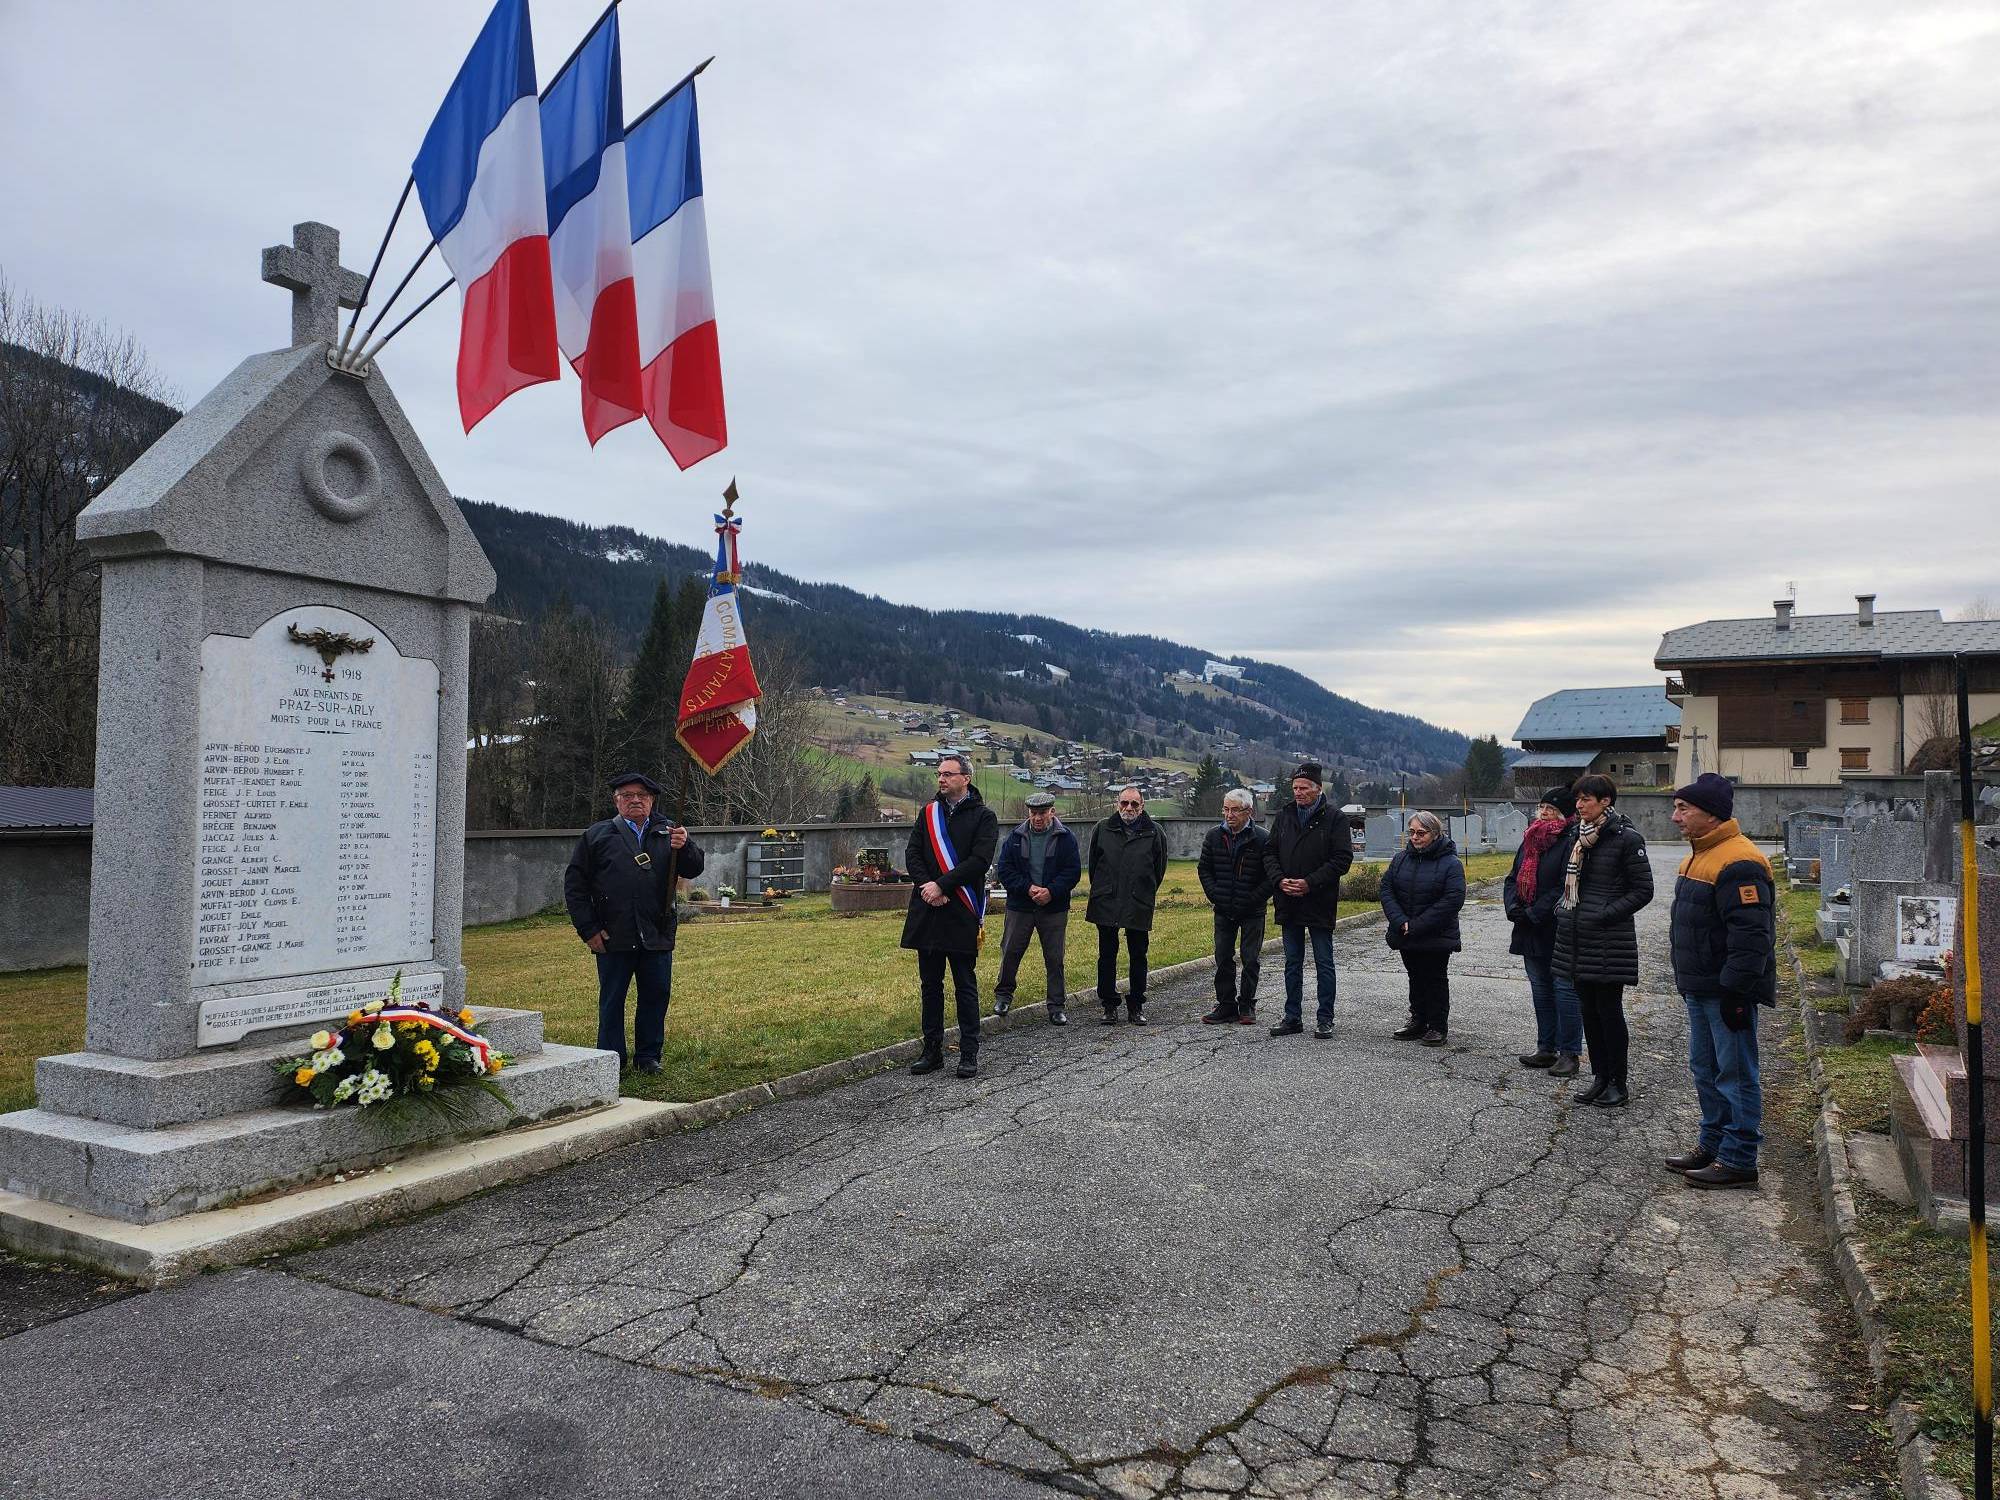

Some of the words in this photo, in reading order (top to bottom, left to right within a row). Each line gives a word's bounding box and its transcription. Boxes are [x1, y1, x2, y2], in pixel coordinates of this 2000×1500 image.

[296, 664, 318, 676] 1914
[342, 668, 362, 681] 1918
[292, 688, 310, 698] AUX
[313, 689, 350, 701] ENFANTS
[352, 693, 364, 703] DE
[279, 698, 376, 717] PRAZ-SUR-ARLY
[269, 714, 301, 725] MORTS
[307, 716, 330, 727] POUR
[335, 719, 347, 728] LA
[351, 720, 383, 730] FRANCE
[306, 988, 330, 999] GUERRE
